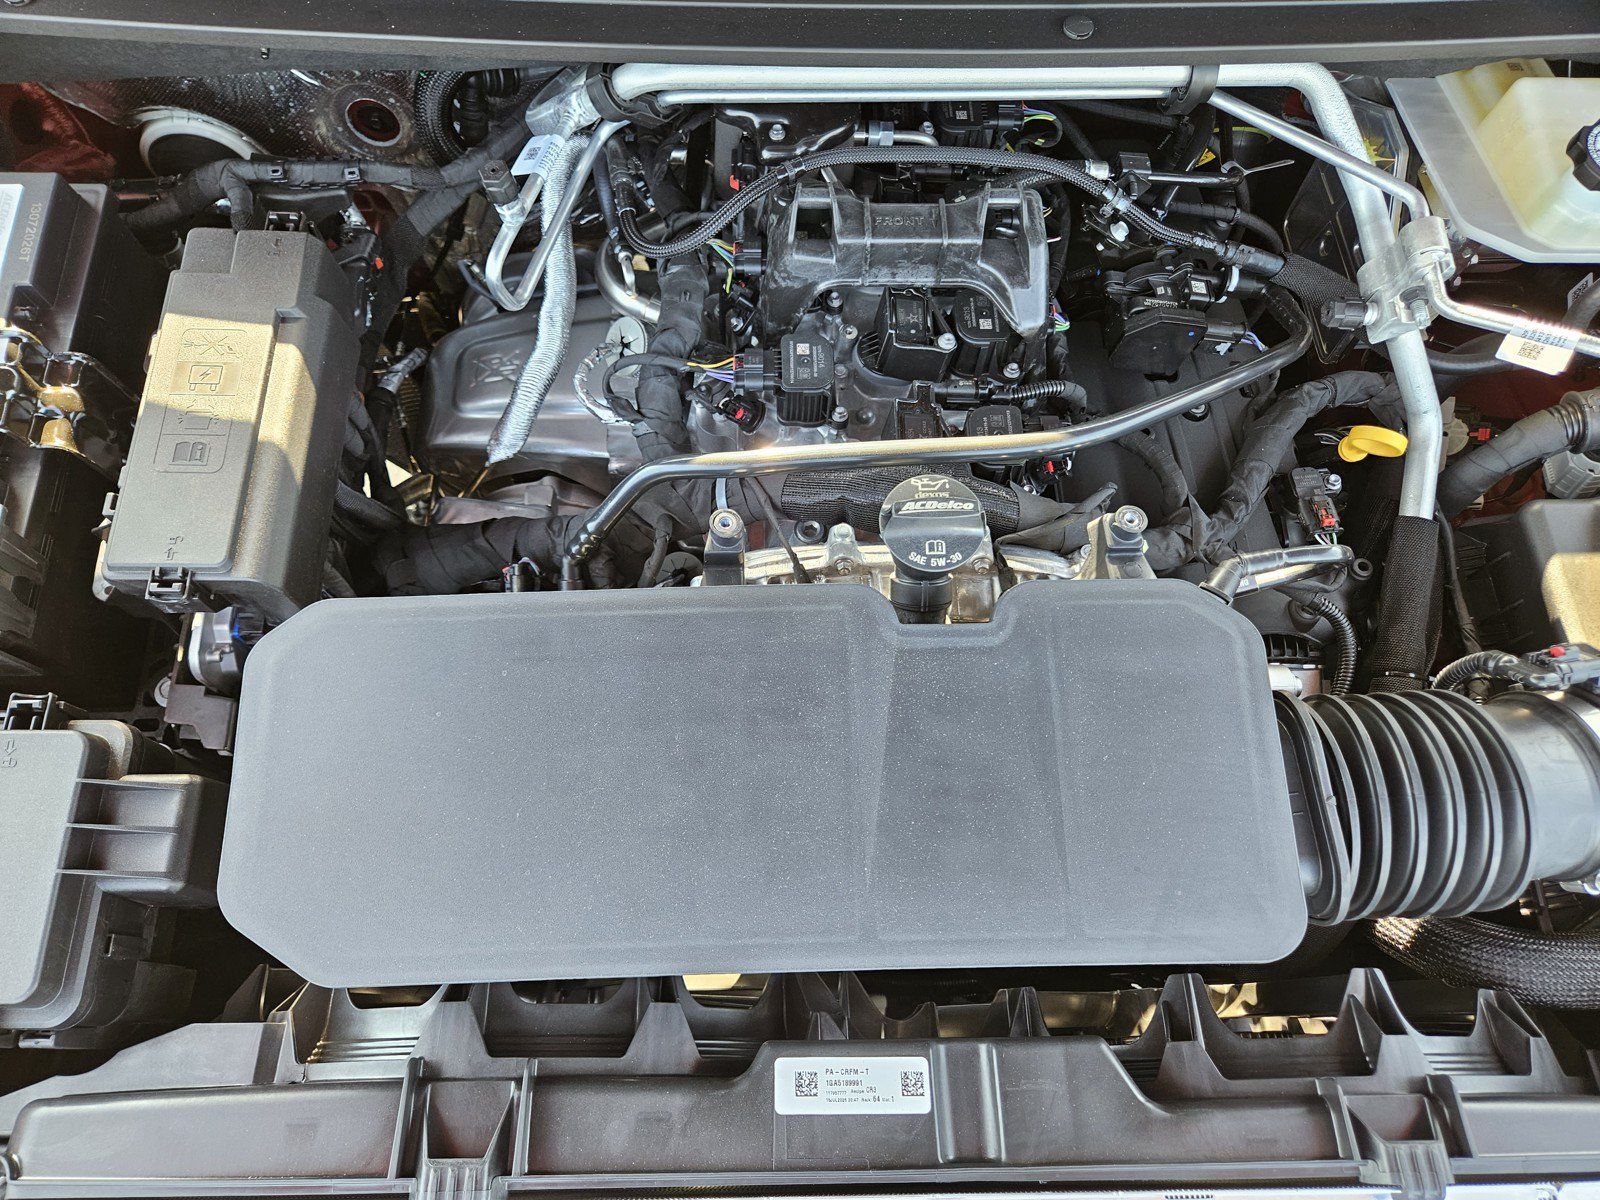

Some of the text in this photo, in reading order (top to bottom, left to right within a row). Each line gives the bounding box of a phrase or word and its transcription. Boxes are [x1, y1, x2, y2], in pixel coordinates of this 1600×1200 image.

[875, 216, 925, 226] FRONT
[901, 501, 974, 511] ACDelco
[908, 551, 963, 567] SAE 5W-30
